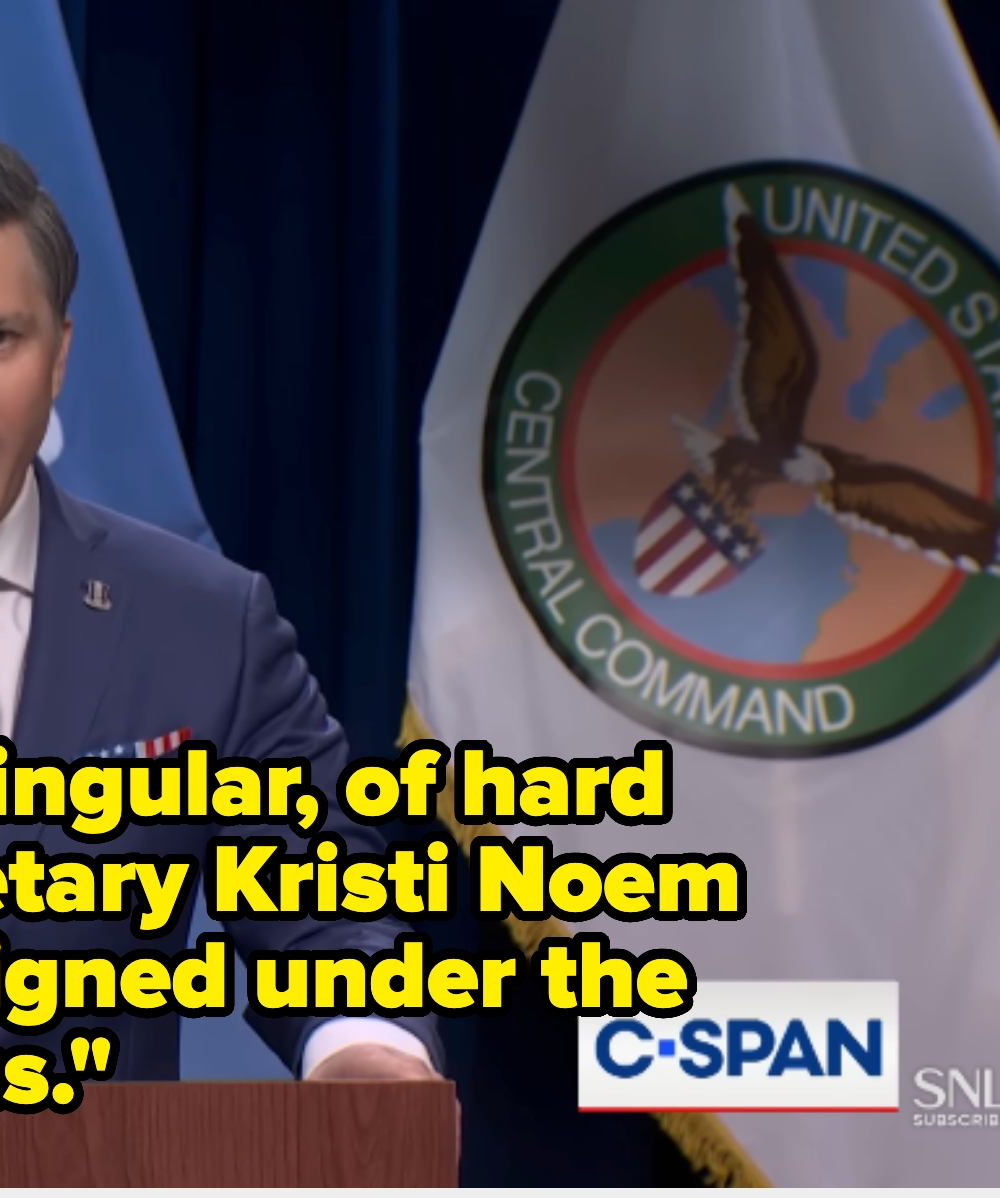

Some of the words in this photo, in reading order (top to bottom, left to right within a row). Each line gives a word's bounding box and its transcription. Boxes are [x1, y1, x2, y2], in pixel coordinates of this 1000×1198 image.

[763, 187, 958, 296] UNITED
[506, 370, 584, 625] CENTRAL
[575, 613, 856, 736] COMMAND
